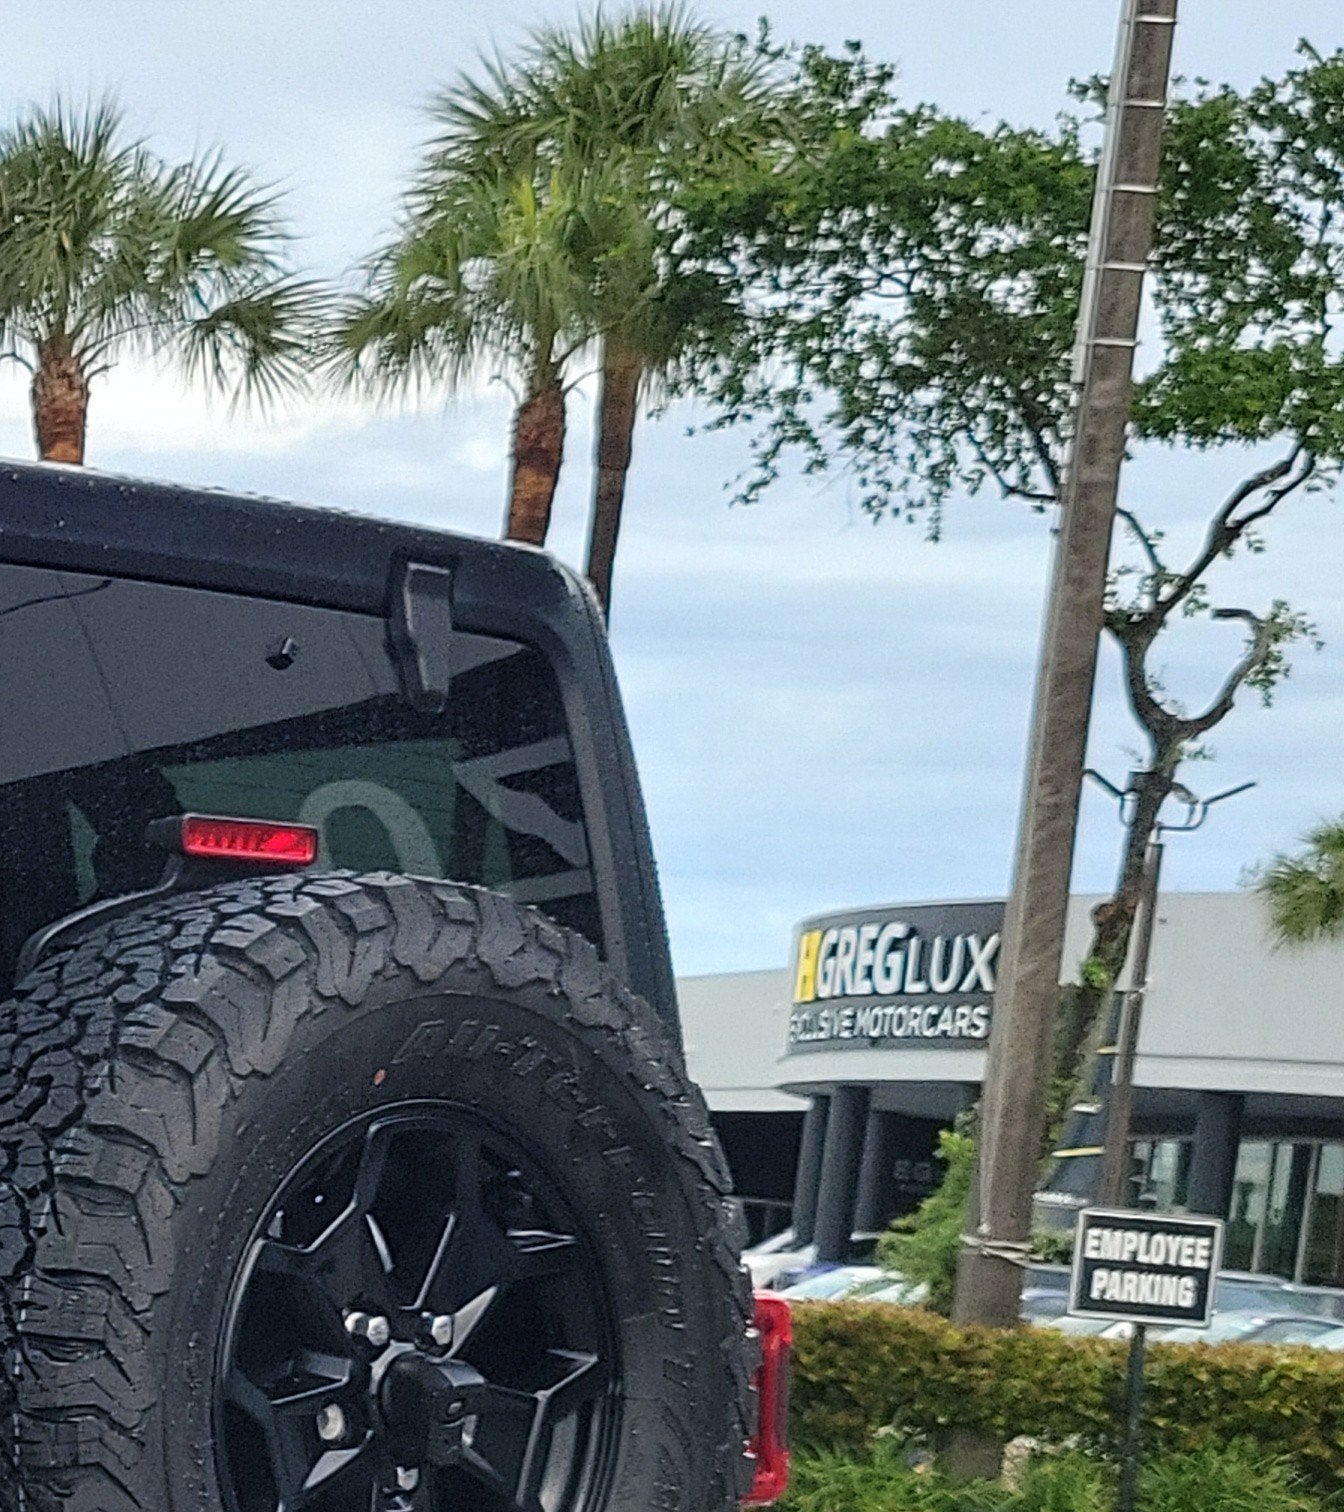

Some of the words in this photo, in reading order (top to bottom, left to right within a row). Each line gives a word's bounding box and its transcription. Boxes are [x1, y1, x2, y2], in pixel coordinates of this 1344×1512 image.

[855, 1004, 992, 1039] MOTORCARS
[1083, 1227, 1211, 1269] EMPLOYEE
[1089, 1267, 1198, 1308] PARKING
